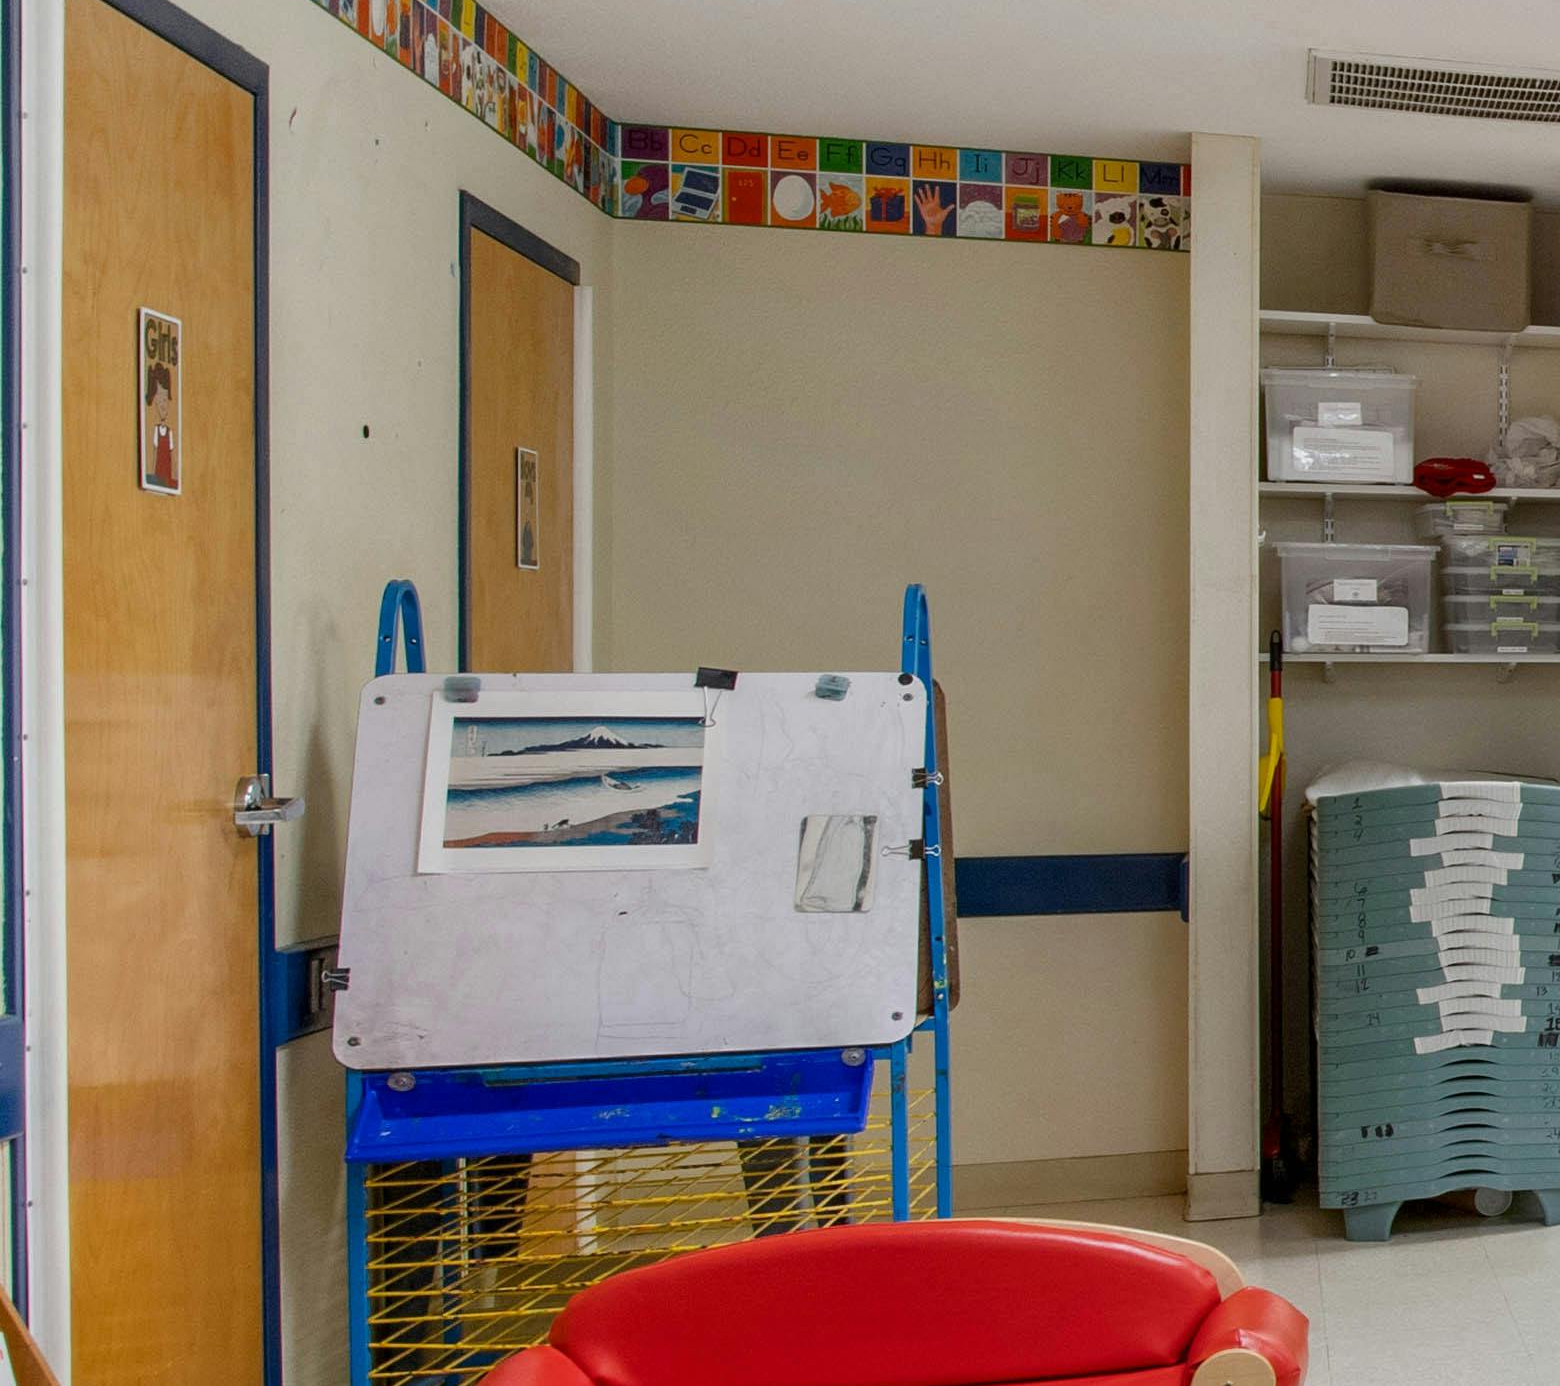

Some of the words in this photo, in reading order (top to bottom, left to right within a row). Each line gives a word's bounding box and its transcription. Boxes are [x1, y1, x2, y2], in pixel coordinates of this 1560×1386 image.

[629, 130, 662, 153] Bb
[679, 134, 712, 156] Cc
[728, 138, 762, 159] Dd
[777, 141, 810, 162] Ee
[826, 143, 858, 163] Ff
[870, 147, 907, 174] Gg
[918, 151, 951, 171] Hh
[973, 154, 989, 174] Ii
[1013, 157, 1041, 183] Jj
[1058, 161, 1086, 181] Kk
[1103, 164, 1125, 184] Ll
